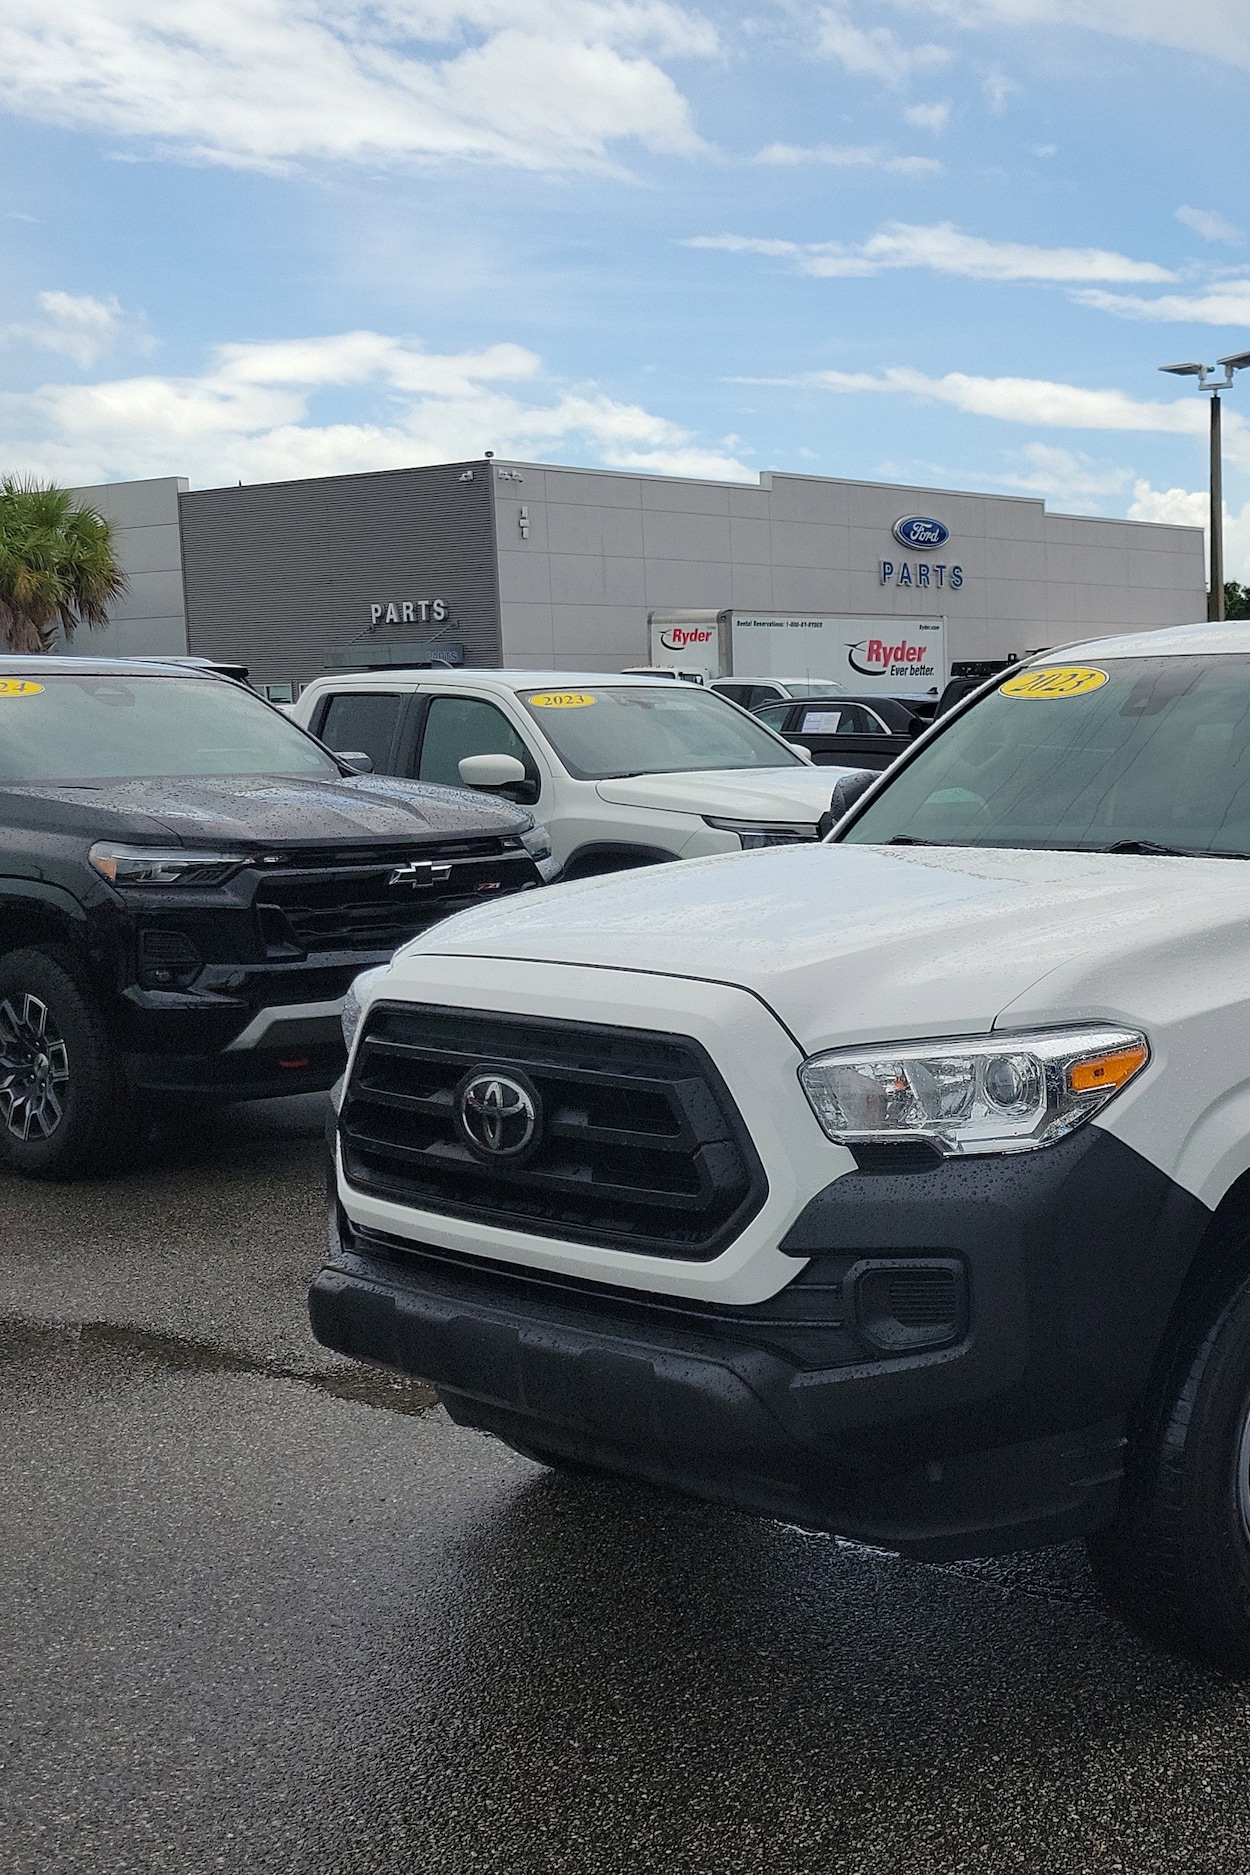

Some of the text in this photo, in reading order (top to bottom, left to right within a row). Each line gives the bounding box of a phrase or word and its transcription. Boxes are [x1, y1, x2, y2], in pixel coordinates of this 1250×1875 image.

[909, 521, 940, 543] Ford
[880, 560, 964, 590] PARTS
[371, 599, 446, 625] PARTS
[672, 627, 713, 646] Ryder
[866, 639, 927, 668] Ryder
[890, 664, 935, 677] Ever better.
[1010, 672, 1096, 692] 2023
[543, 694, 585, 706] 2023
